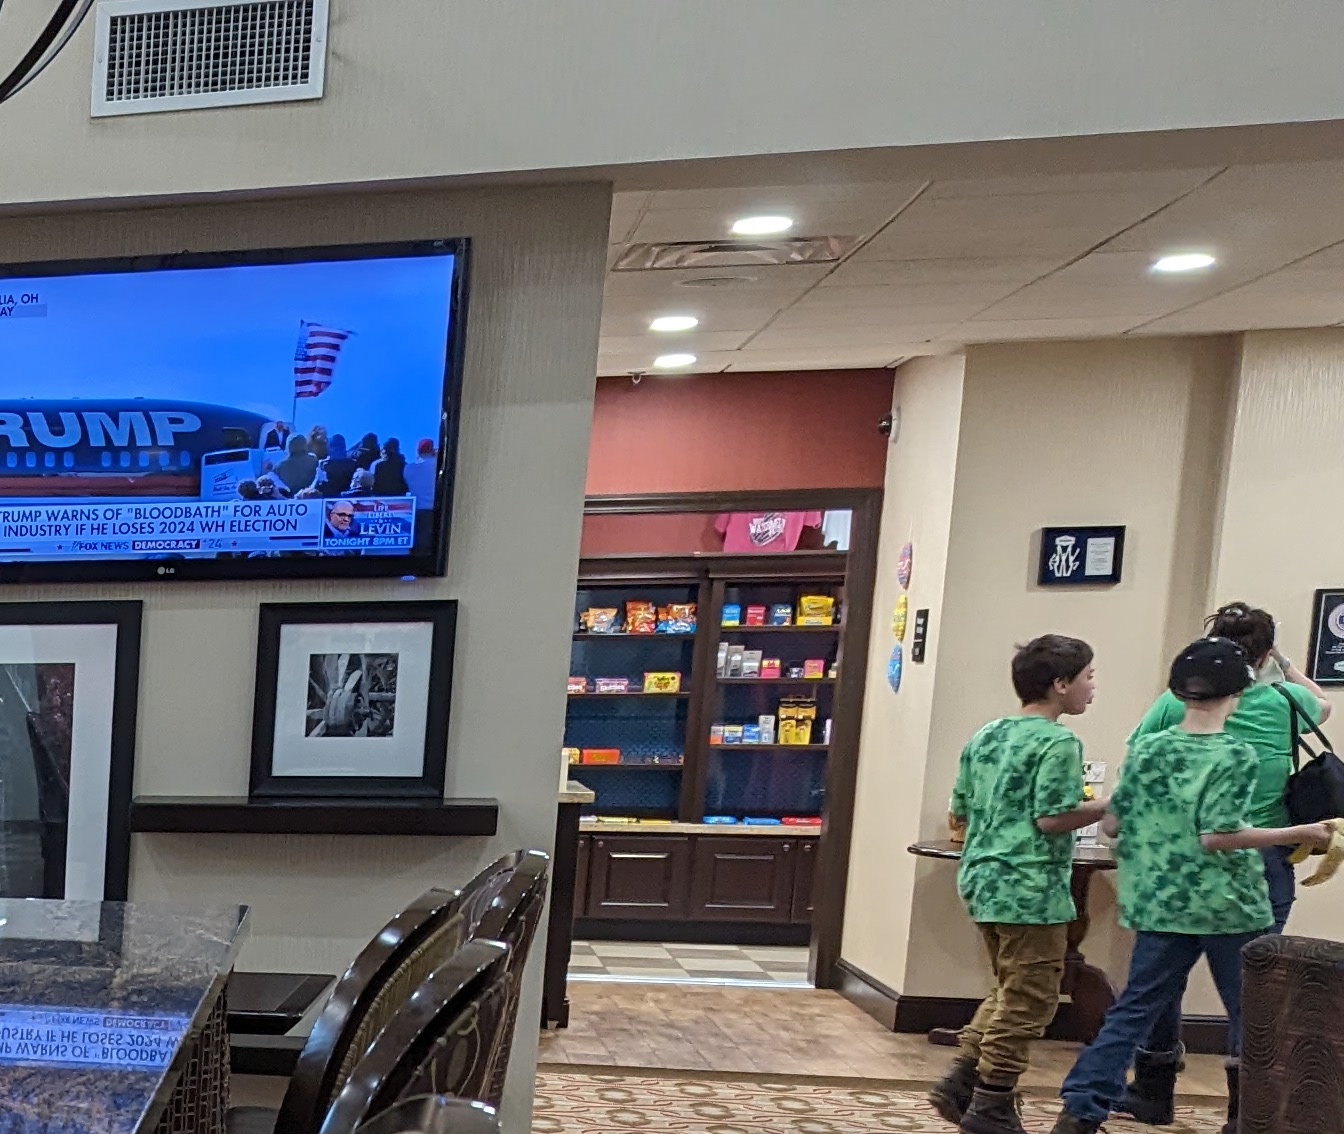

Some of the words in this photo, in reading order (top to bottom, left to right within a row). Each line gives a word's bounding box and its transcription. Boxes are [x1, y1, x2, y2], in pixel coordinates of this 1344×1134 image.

[21, 293, 39, 304] OH
[44, 508, 99, 522] WARNS
[103, 508, 123, 520] OF
[127, 504, 229, 520] "BLOODBATH"
[234, 503, 263, 517] FOR
[266, 503, 308, 517] AUTO
[3, 523, 71, 537] INDUSTRY
[75, 523, 89, 536] IF
[92, 523, 108, 535] HE
[112, 522, 155, 535] LOSES
[160, 521, 195, 534] 2024
[200, 520, 225, 533] WH
[229, 518, 298, 533] ELECTION
[360, 523, 402, 535] LEVIN
[79, 541, 99, 551] FOX
[101, 541, 129, 551] NEWS
[134, 540, 198, 550] DEMOCRACY
[325, 537, 371, 547] TONIGHT
[373, 537, 394, 546] 8PM
[398, 537, 409, 546] ET
